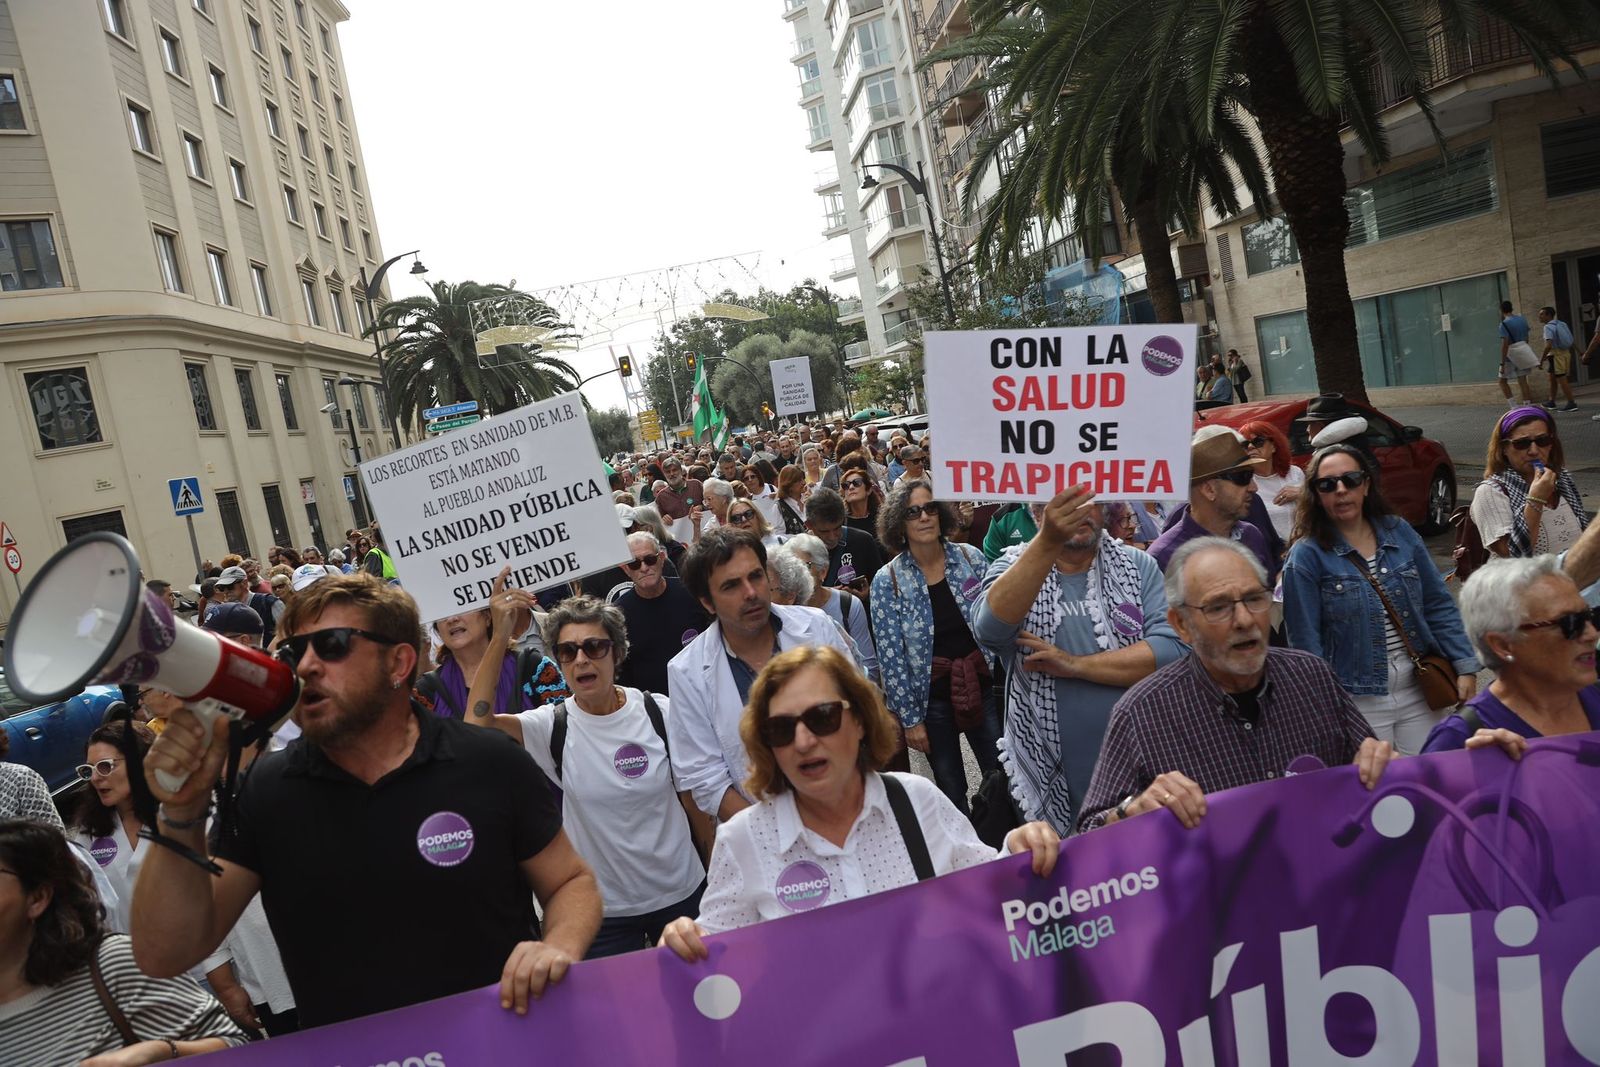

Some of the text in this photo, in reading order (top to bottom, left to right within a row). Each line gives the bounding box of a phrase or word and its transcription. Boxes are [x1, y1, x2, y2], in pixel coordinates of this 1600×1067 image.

[990, 334, 1129, 369] CON LA
[1143, 346, 1182, 366] PODEMOS
[992, 372, 1125, 412] SALUD
[368, 404, 578, 485] LOS RECORTES EN SANIDAD DE M.B.
[1001, 420, 1118, 455] NO SE
[428, 448, 520, 490] ESTÁ MATANDO
[945, 459, 1174, 496] TRAPICHEA
[423, 465, 547, 518] AL PUEBLO ANDALUZ
[395, 478, 603, 558] LA SANIDAD PÚBLICA
[441, 522, 570, 577] NO SE VENDE
[453, 584, 478, 606] SE
[477, 552, 580, 599] DFIENDE
[1113, 607, 1142, 631] PODEMOS
[615, 755, 648, 766] PODEMOS
[419, 829, 473, 849] PODEMOS
[777, 877, 829, 897] PODEMOS
[1001, 866, 1160, 932] Podemos
[1008, 915, 1116, 962] Málaga
